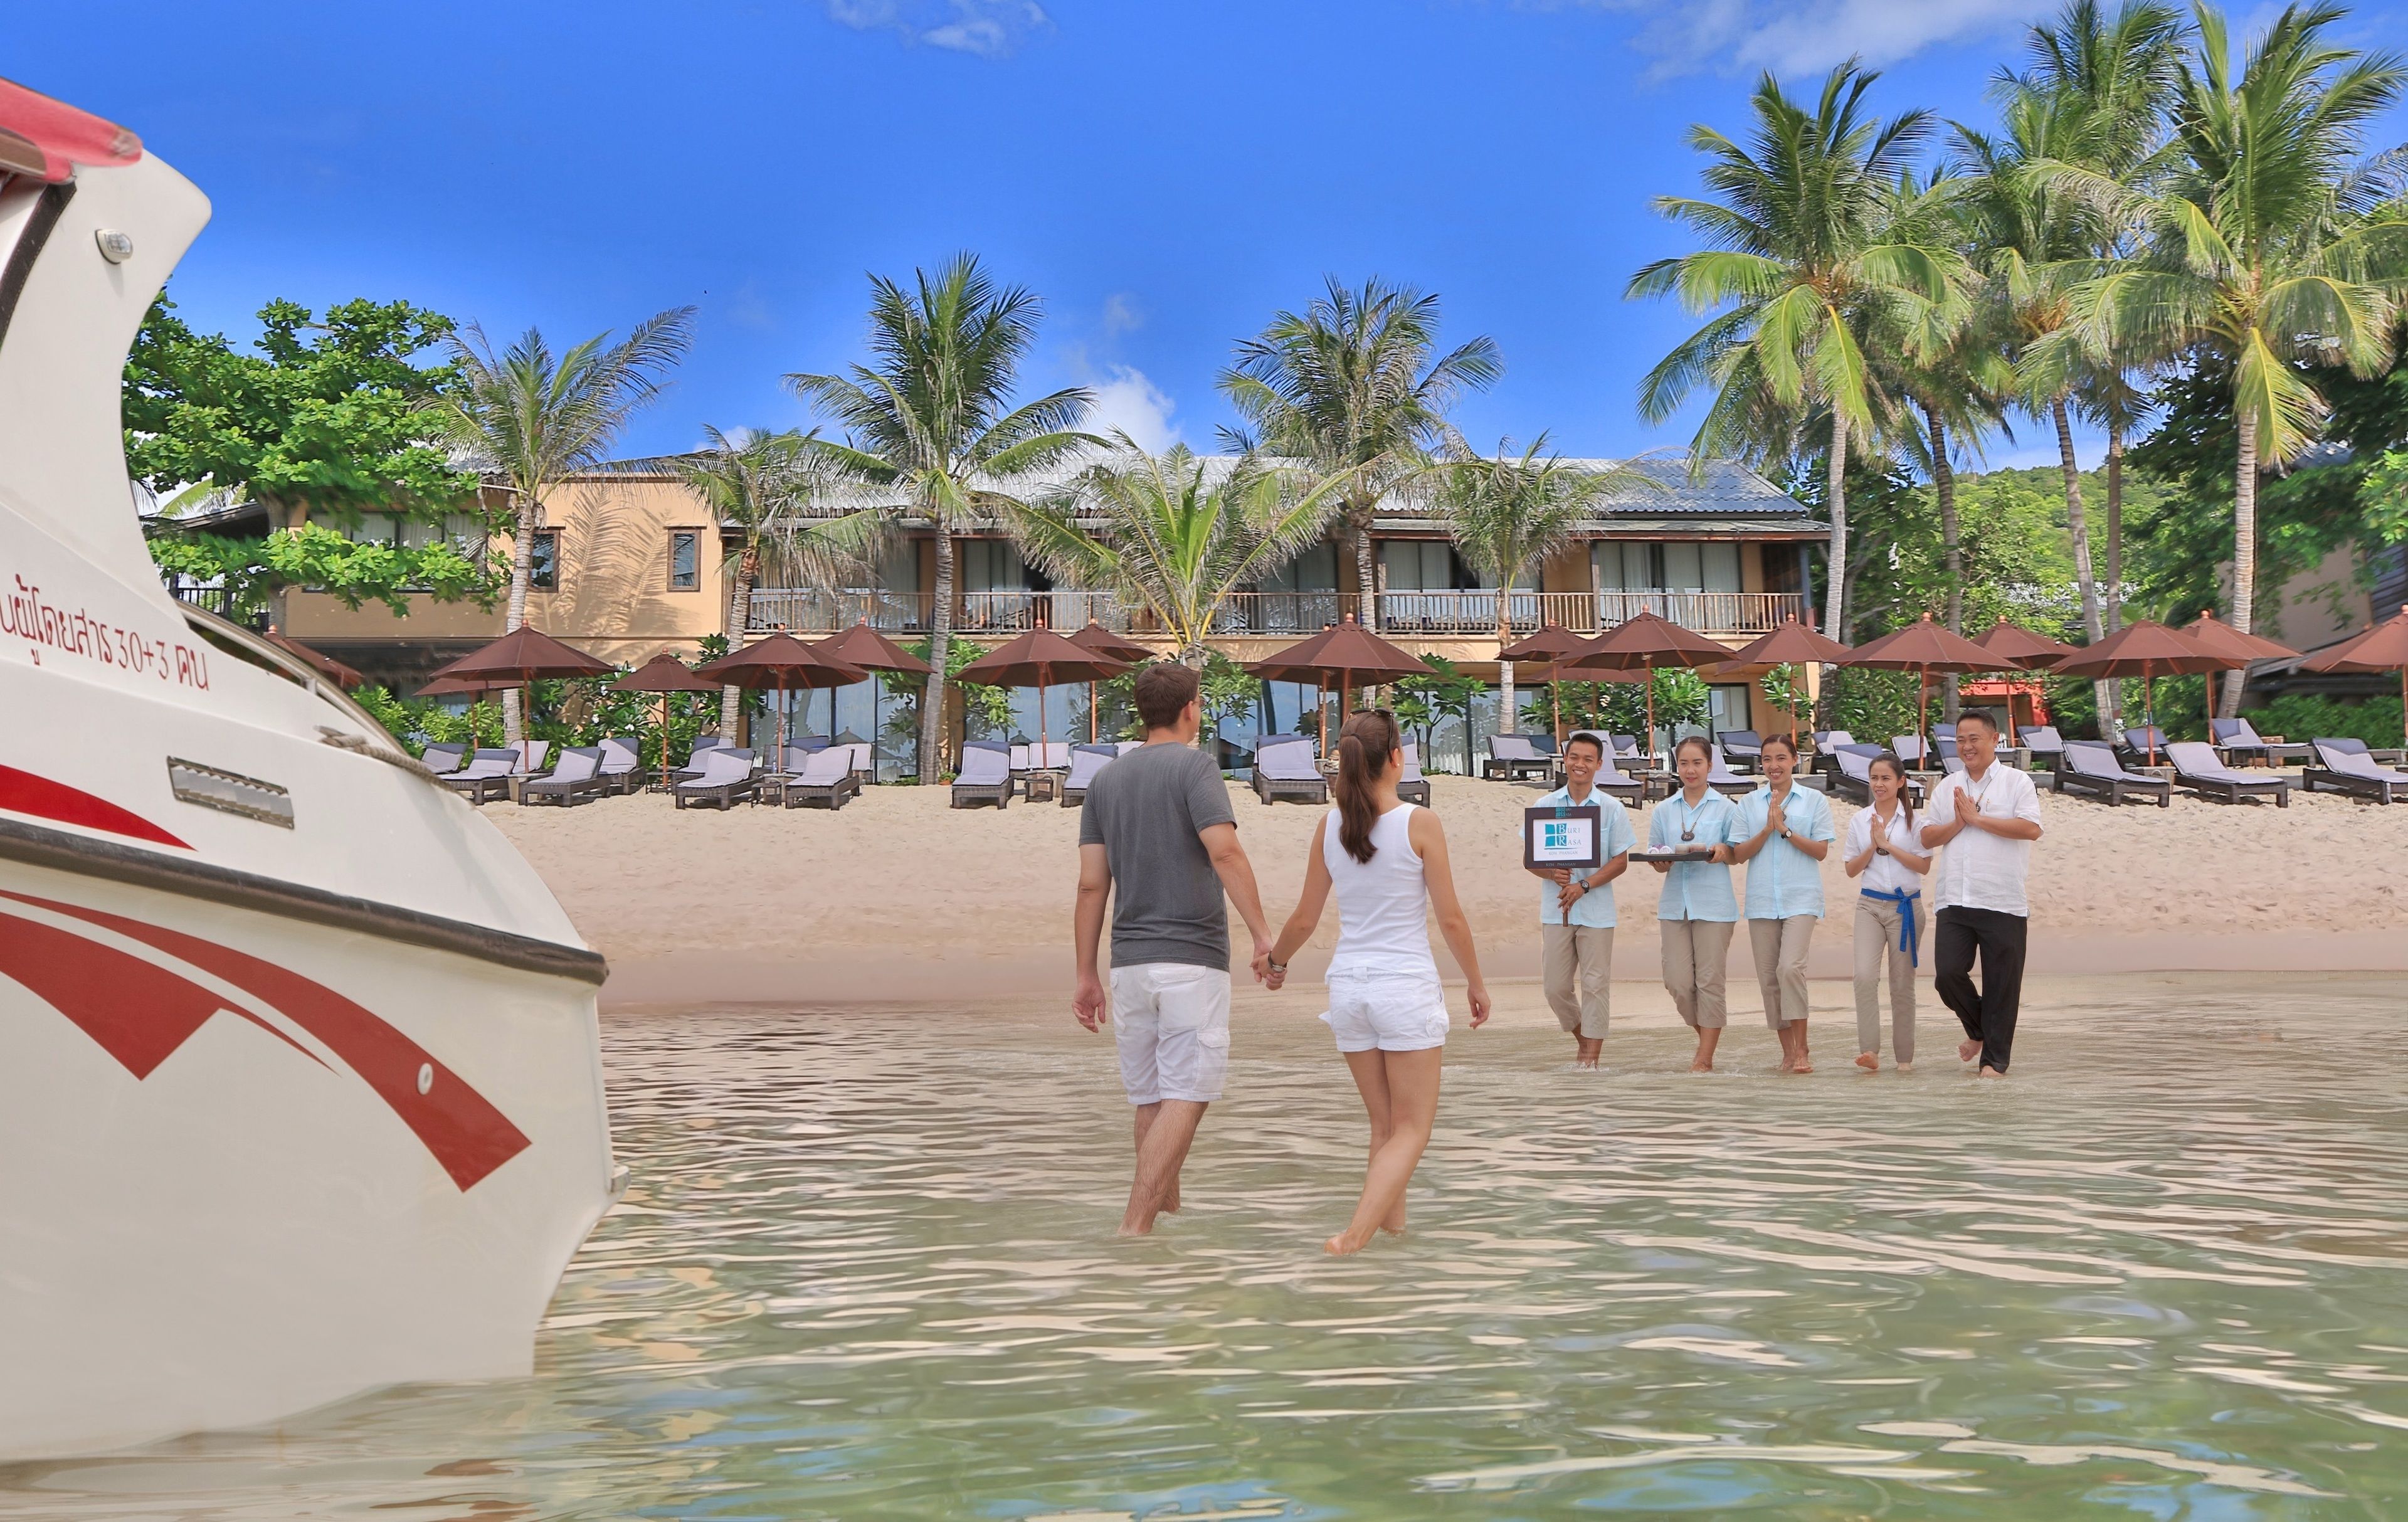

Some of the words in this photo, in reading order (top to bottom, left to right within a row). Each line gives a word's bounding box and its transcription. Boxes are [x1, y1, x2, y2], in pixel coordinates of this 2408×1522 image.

[114, 628, 169, 680] 30+3
[174, 644, 209, 691] คน
[1558, 824, 1580, 833] BURI
[1558, 836, 1582, 845] RASA
